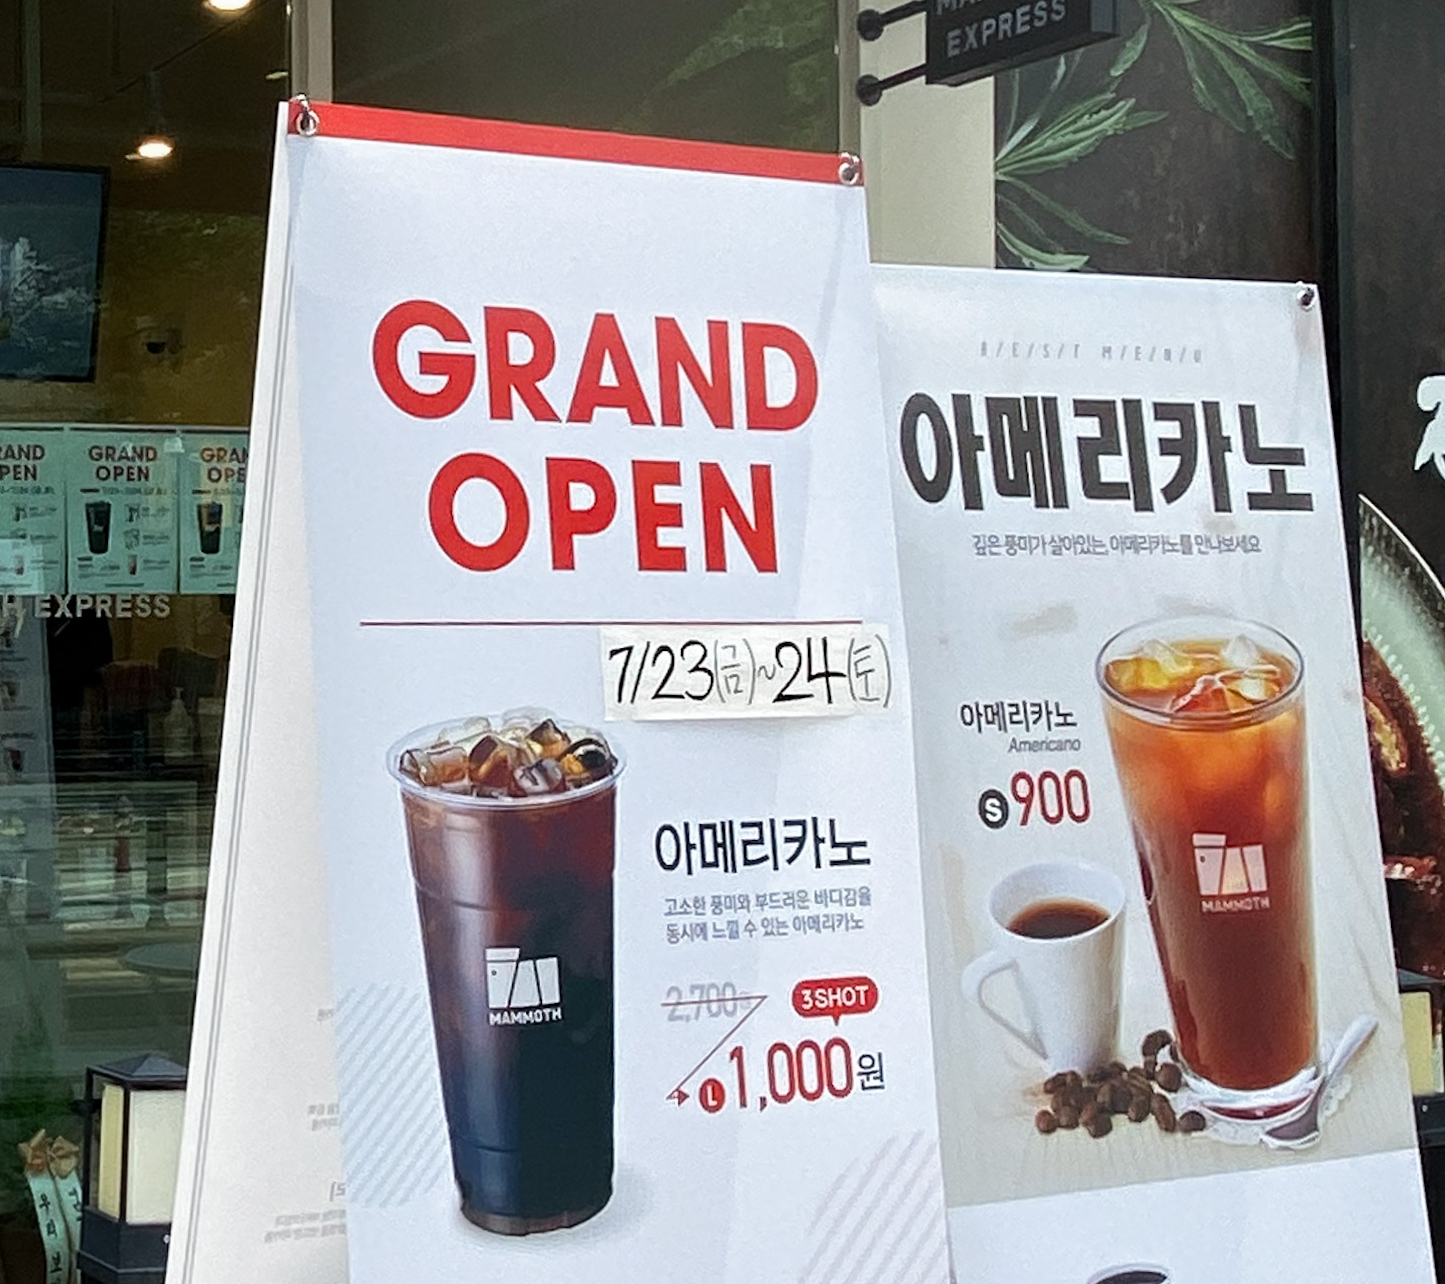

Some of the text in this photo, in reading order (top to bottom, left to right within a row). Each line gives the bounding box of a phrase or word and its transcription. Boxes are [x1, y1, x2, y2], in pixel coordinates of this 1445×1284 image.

[372, 298, 819, 432] GRAND
[88, 444, 158, 462] GRAND
[199, 446, 249, 464] GRAN
[899, 392, 1315, 513] 아메리카노
[95, 465, 150, 483] OPEN
[207, 466, 246, 484] OPE
[428, 451, 779, 574] OPEN
[1005, 535, 1048, 557] 풍미가
[1194, 535, 1262, 555] 만나보세요
[34, 592, 172, 620] EXPRESS
[959, 700, 1078, 733] 아메리카노
[1008, 736, 1081, 754] Americano
[1010, 769, 1091, 826] 900
[655, 817, 871, 876] 아메리카노
[663, 886, 872, 917] 고소한 풍미와 부드러운 바디감을
[1202, 896, 1270, 913] MAMMOTH
[666, 921, 707, 945] 동시에
[743, 918, 758, 939] 수
[761, 916, 789, 937] 있는
[792, 913, 865, 936] 아메리카노
[801, 985, 871, 1010] 3SHOT
[489, 1007, 562, 1026] MAMMOTH
